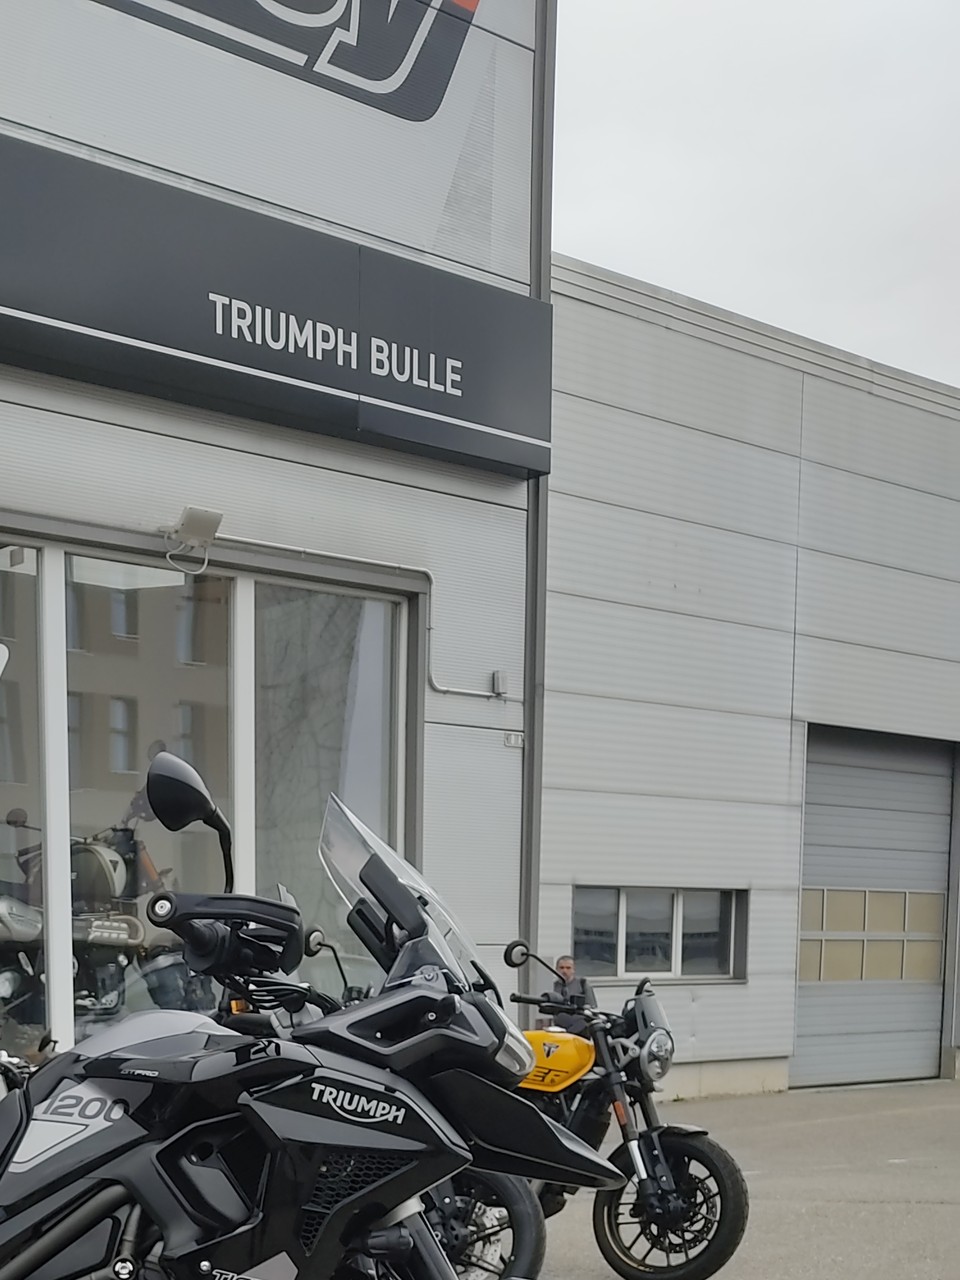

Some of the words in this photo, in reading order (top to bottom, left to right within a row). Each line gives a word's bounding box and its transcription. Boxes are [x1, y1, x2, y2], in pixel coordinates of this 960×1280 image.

[208, 292, 358, 370] TRIUMPH
[370, 337, 463, 397] BULLE
[41, 1093, 131, 1123] 1200
[310, 1082, 407, 1125] TRIUMPH
